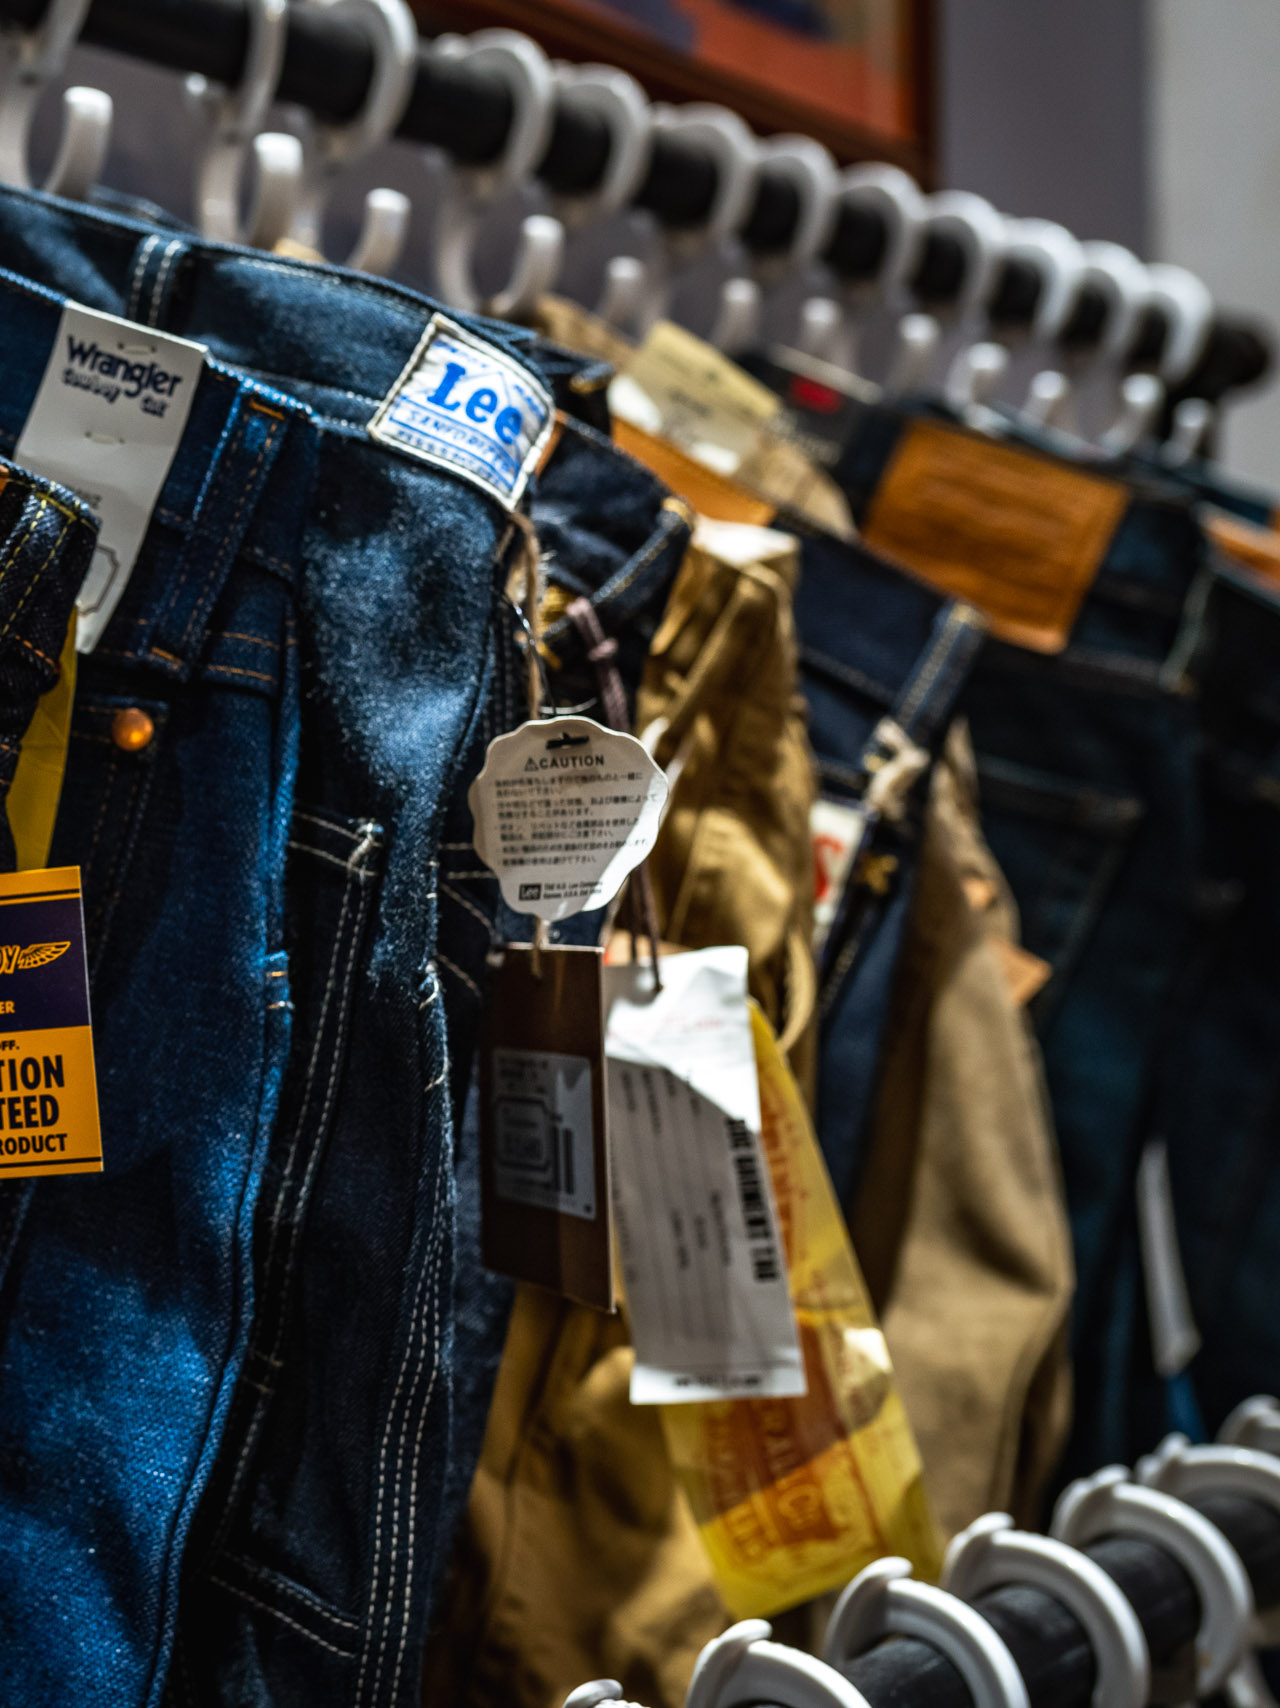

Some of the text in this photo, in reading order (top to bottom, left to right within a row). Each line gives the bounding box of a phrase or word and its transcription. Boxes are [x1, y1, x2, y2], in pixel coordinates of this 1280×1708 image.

[67, 334, 183, 398] Wrangler
[426, 362, 523, 445] Lee
[538, 754, 605, 770] CAUTION
